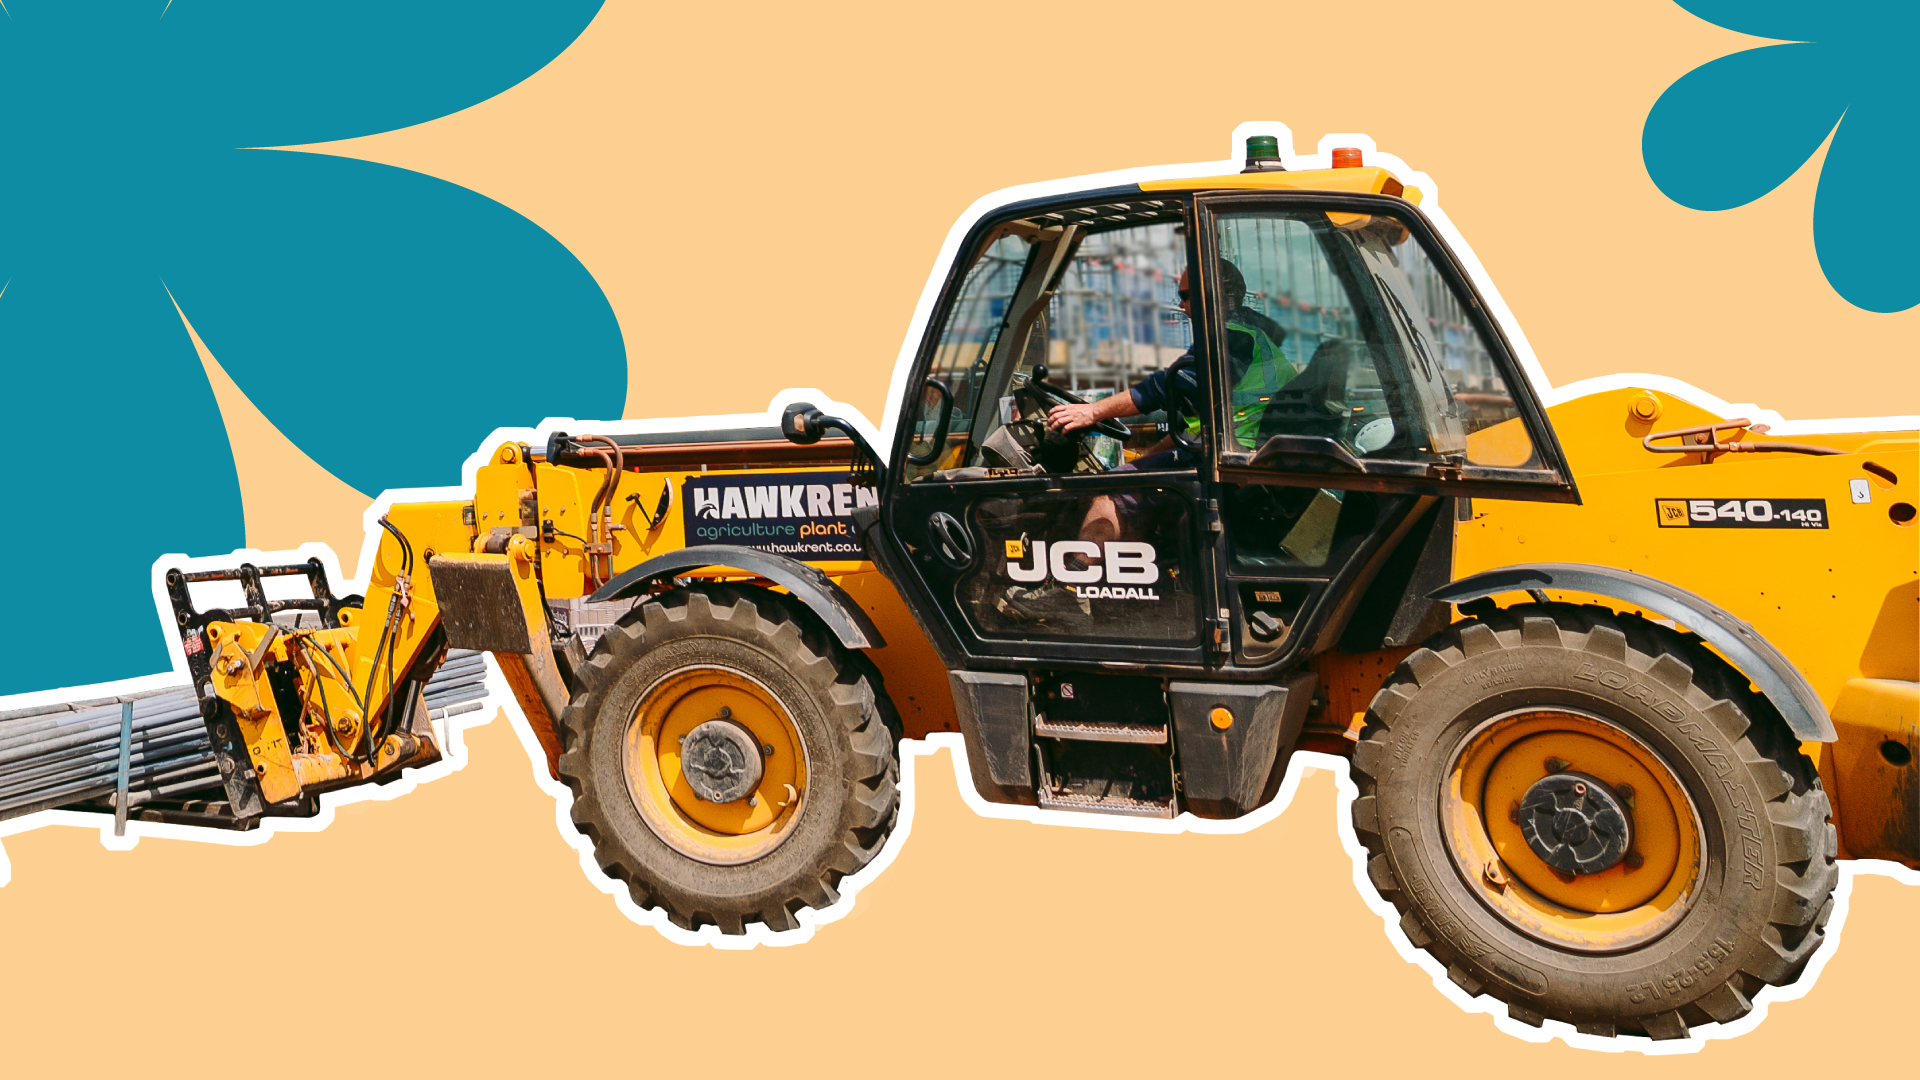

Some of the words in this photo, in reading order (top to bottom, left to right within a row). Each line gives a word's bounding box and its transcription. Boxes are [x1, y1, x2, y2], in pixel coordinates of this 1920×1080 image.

[1689, 500, 1821, 521] 540-140
[697, 522, 795, 540] agriculture
[800, 521, 847, 539] plant
[1006, 540, 1159, 584] JCB
[1076, 586, 1159, 600] LOADALL
[1574, 662, 1764, 890] LOADMASTER
